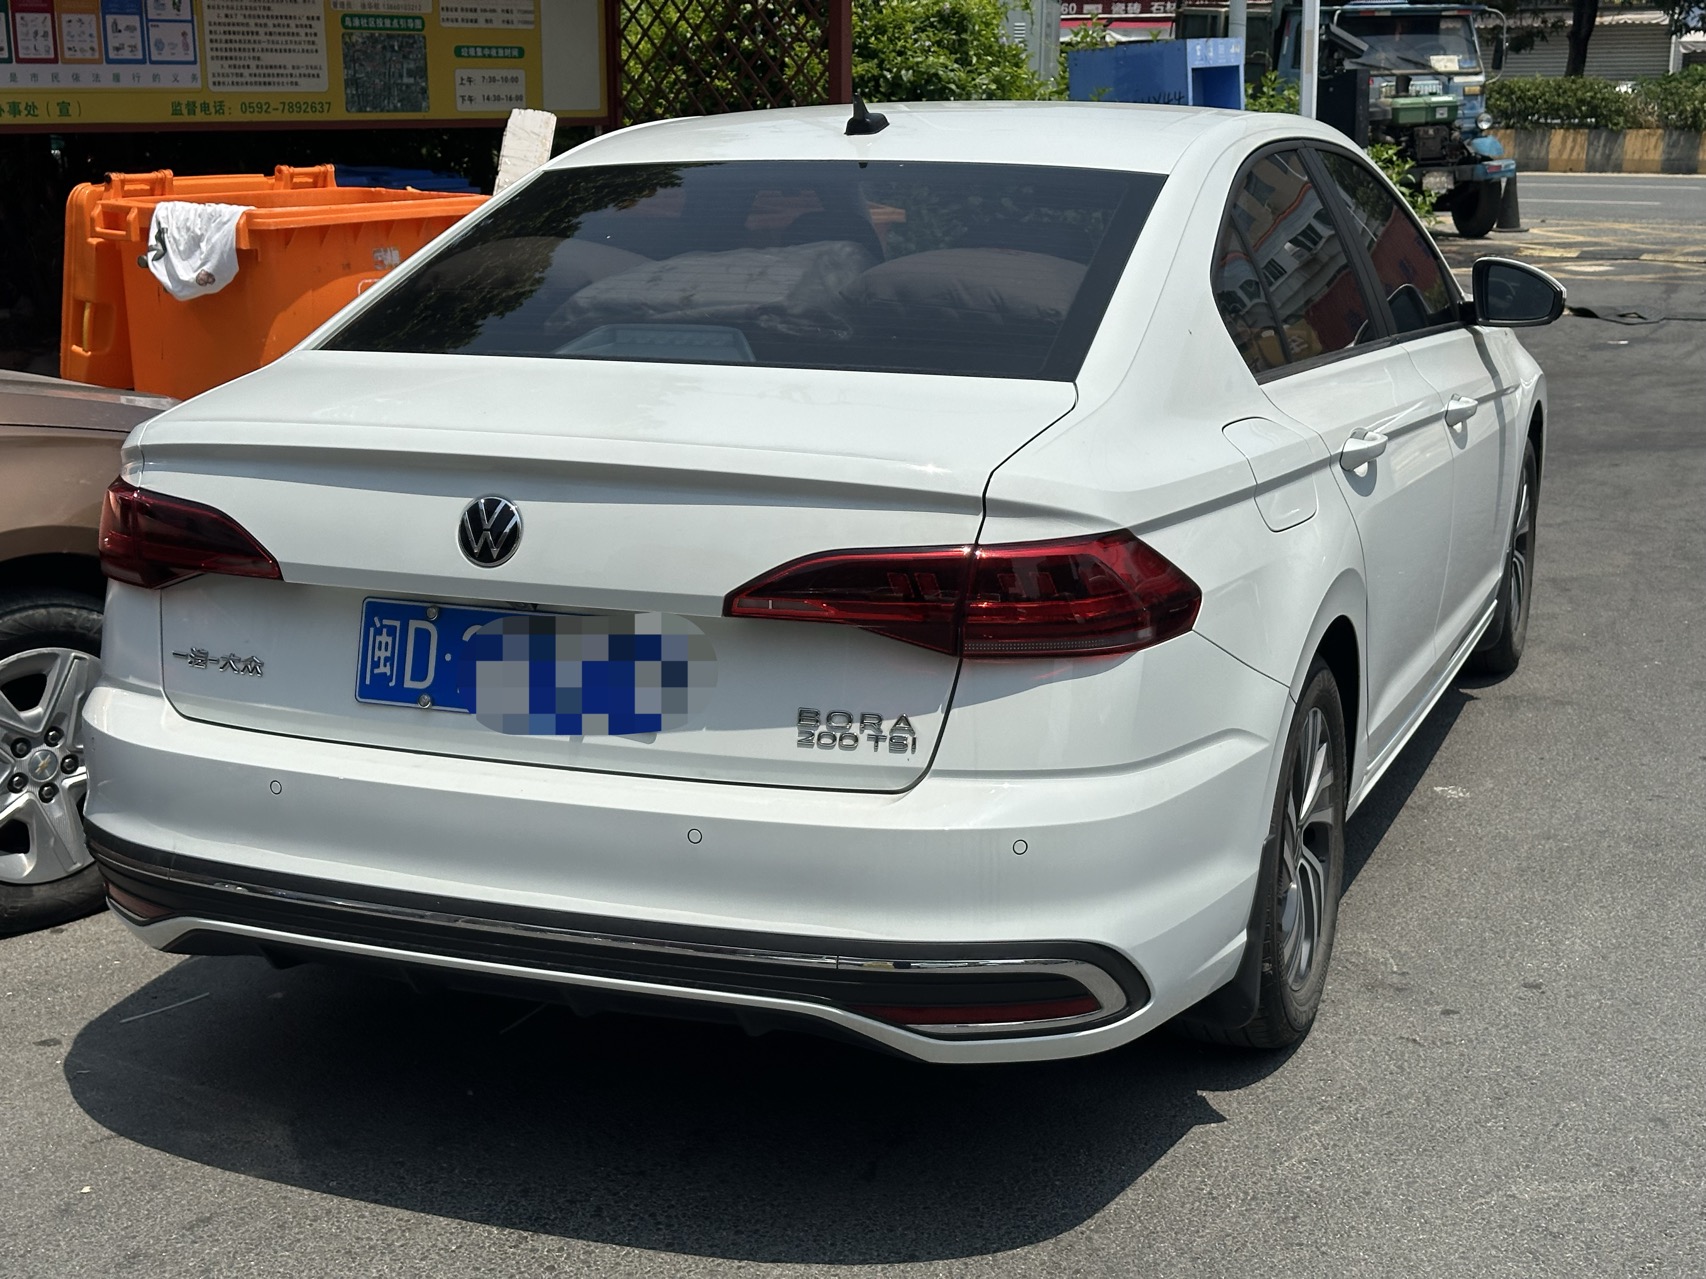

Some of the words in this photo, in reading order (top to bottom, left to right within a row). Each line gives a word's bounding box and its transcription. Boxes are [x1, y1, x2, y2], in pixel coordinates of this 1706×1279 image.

[796, 706, 917, 737] BORA
[796, 729, 860, 752] 200
[866, 733, 918, 755] TSI
